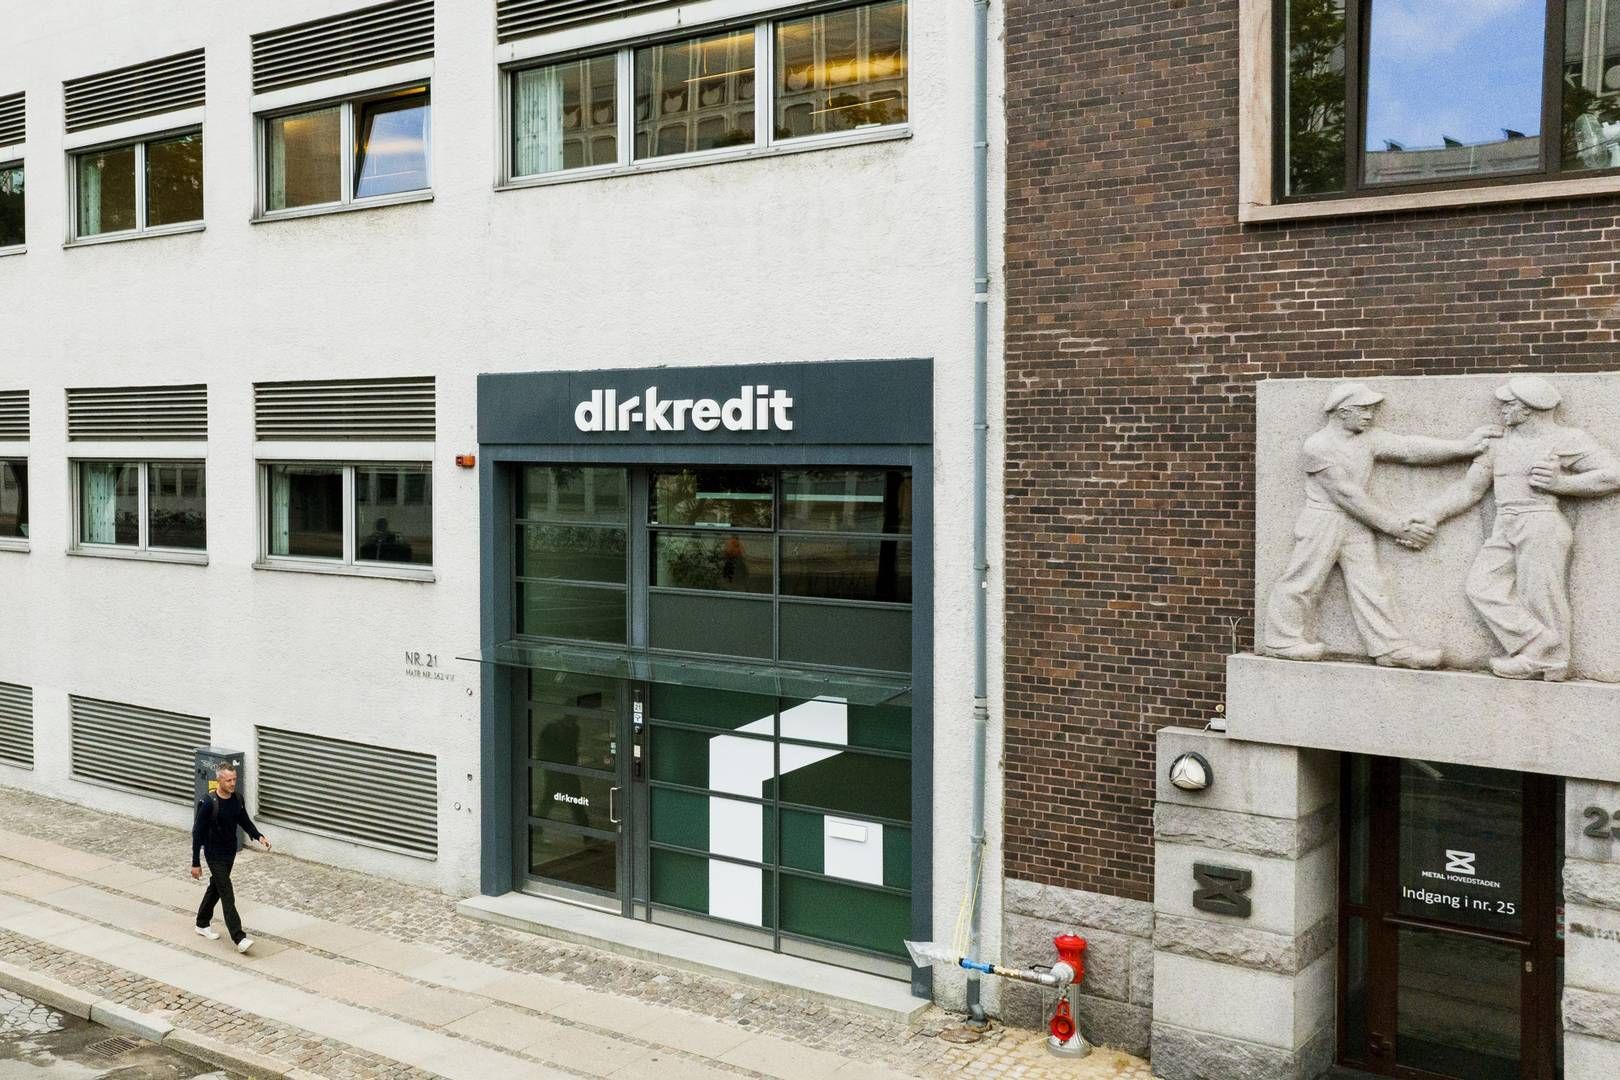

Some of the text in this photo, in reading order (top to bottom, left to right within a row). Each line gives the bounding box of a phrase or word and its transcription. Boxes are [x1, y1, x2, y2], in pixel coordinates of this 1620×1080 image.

[574, 385, 794, 432] dlr-kredit
[405, 651, 438, 668] NR. 21
[1421, 870, 1501, 889] METAL HOVEDSTADEN
[1402, 886, 1460, 908] Indgang
[1473, 900, 1492, 911] nr.
[1496, 900, 1516, 915] 25
